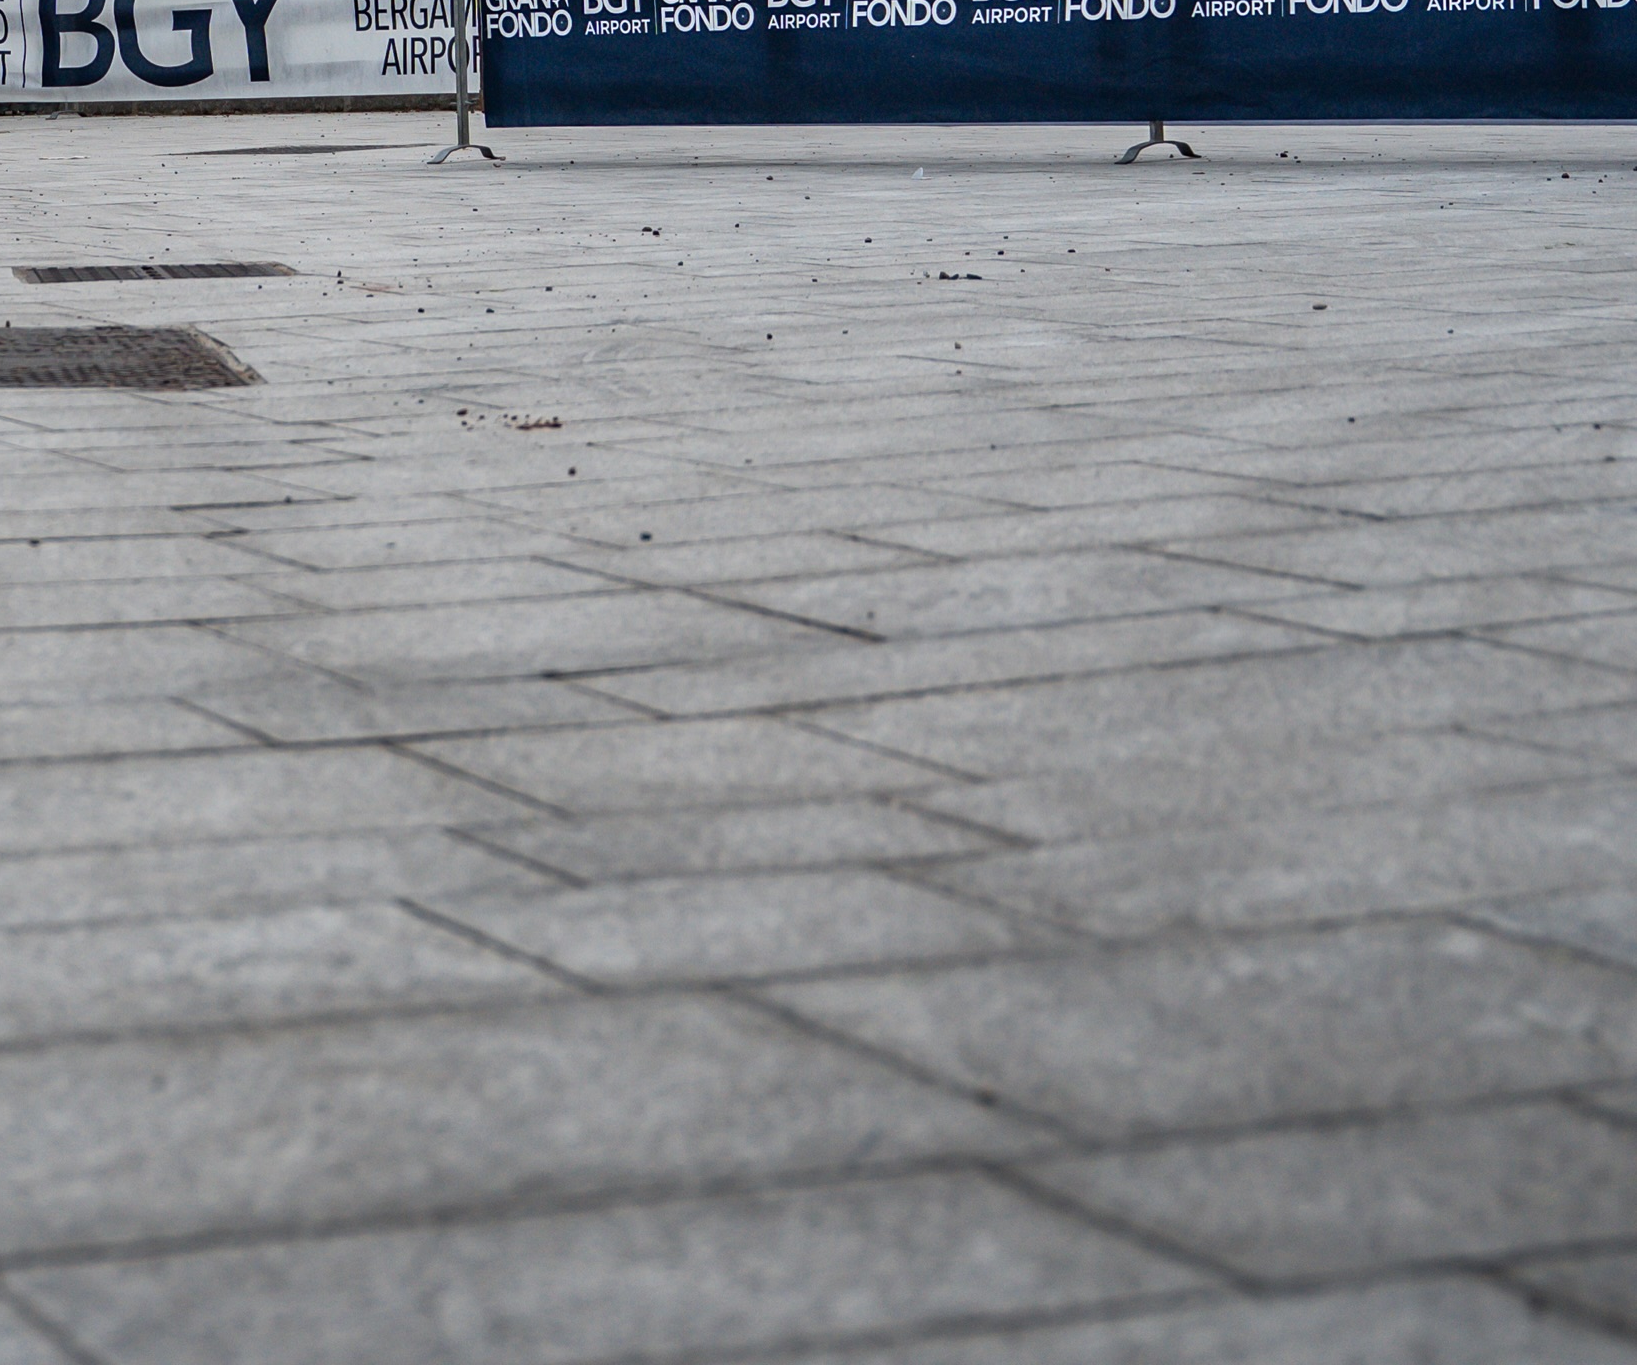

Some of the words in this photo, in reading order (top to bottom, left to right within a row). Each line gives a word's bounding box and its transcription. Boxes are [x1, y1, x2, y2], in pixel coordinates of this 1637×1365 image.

[972, 6, 1052, 24] AIRPORT
[1191, 0, 1275, 17] AIRPORT
[486, 9, 572, 39] FONDO
[661, 2, 754, 33] FONDO
[768, 13, 840, 29] AIRPORT
[585, 19, 650, 35] AIRPORT
